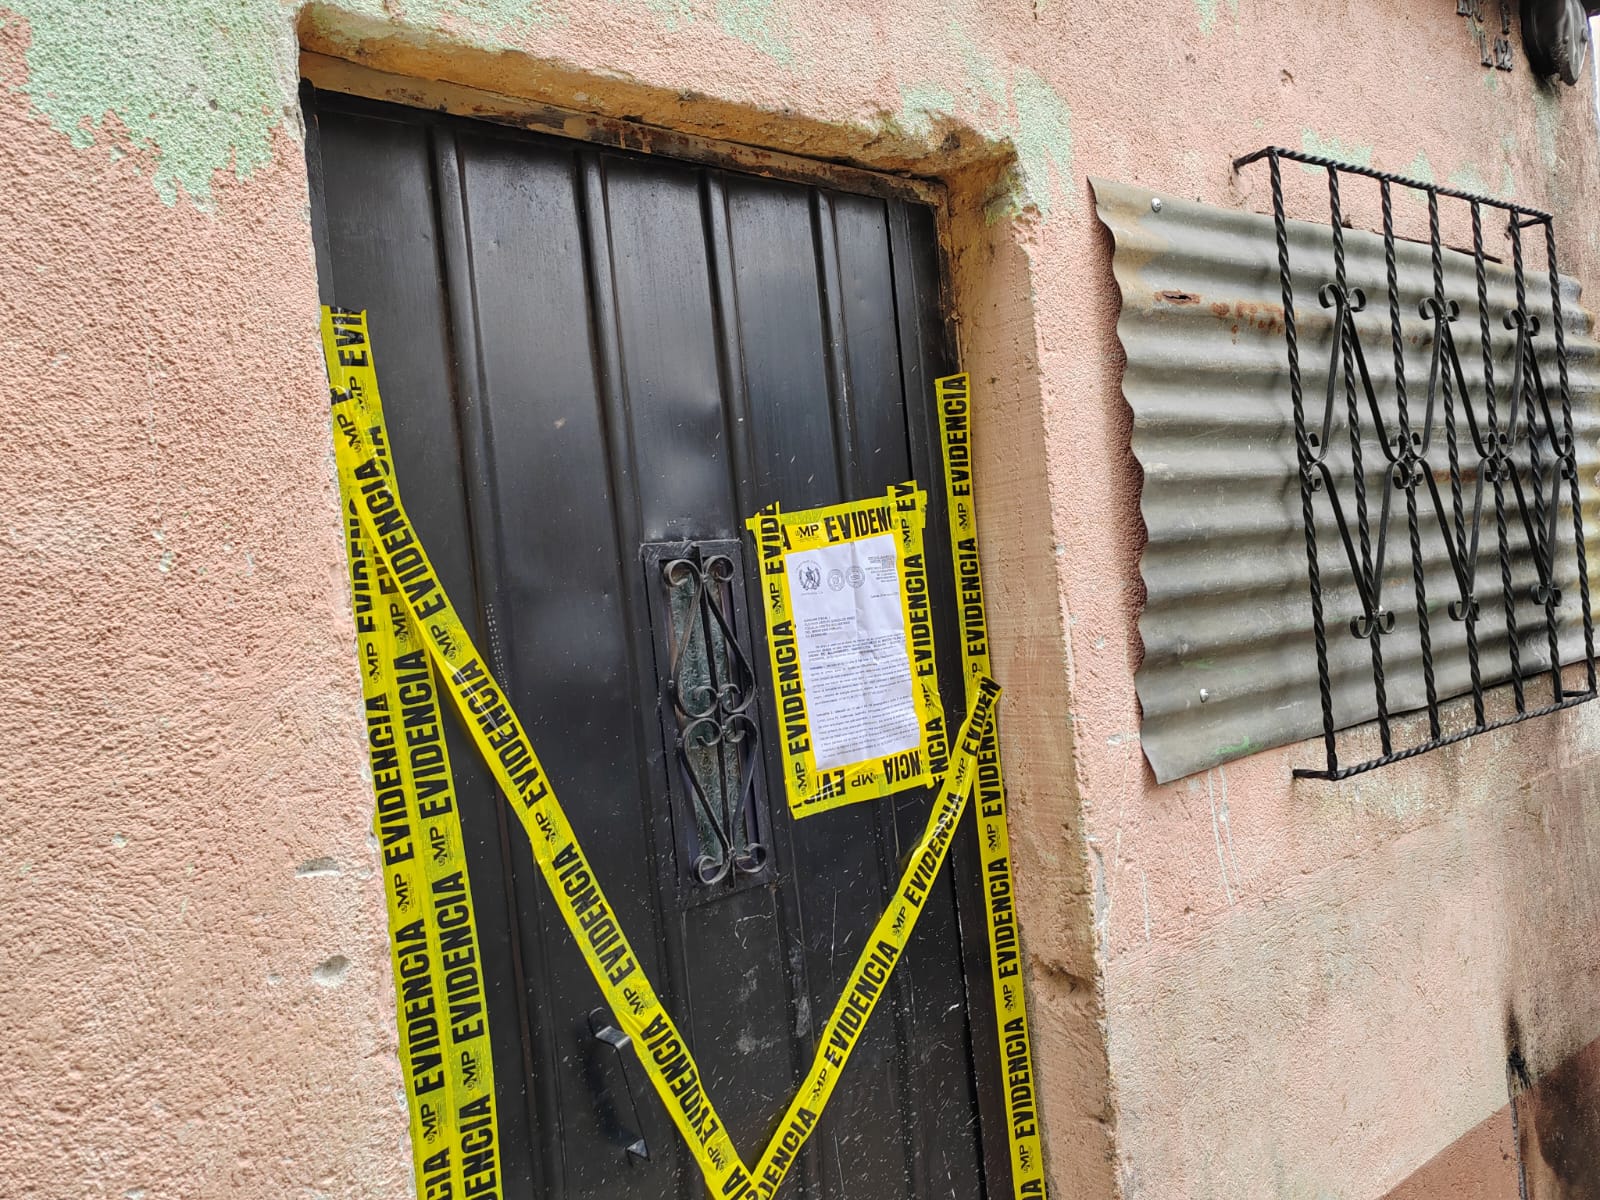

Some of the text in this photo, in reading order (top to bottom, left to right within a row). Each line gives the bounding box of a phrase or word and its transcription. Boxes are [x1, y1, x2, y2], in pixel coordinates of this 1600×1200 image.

[336, 413, 360, 449] MP
[942, 375, 970, 499] EVIDENCIA
[798, 524, 819, 538] MP
[902, 519, 911, 543] MP
[958, 502, 969, 528] MP
[354, 457, 447, 621] EVIDENCIA
[769, 582, 782, 609] MP
[957, 537, 986, 658] EVIDENCIA
[390, 603, 408, 637] MP
[903, 553, 934, 677] EVIDENCIA
[431, 624, 456, 656] MP
[366, 642, 380, 677] MP
[772, 619, 810, 756] EVIDENCIA
[393, 649, 452, 819] EVIDENCIA
[451, 658, 548, 809] EVIDENCIA
[366, 693, 414, 866] EVIDENCIA
[795, 762, 808, 789] MP
[851, 773, 875, 788] MP
[429, 826, 448, 861] MP
[535, 812, 556, 842] MP
[987, 824, 997, 849] MP
[394, 873, 410, 908] MP
[551, 842, 636, 987] EVIDENCIA
[812, 1068, 828, 1096] MP
[824, 940, 898, 1069] EVIDENCIA
[891, 906, 908, 932] MP
[903, 792, 964, 908] EVIDENCIA
[955, 758, 965, 783] MP
[987, 857, 1018, 979] EVIDENCIA
[432, 871, 485, 1044] EVIDENCIA
[395, 919, 445, 1096] EVIDENCIA
[623, 987, 644, 1015] MP
[1003, 984, 1013, 1010] MP
[461, 1051, 477, 1086] MP
[640, 1013, 719, 1148] EVIDENCIA
[1004, 1016, 1036, 1140] EVIDENCIA
[421, 1104, 437, 1139] MP
[708, 1146, 723, 1170] MP
[1018, 1144, 1030, 1170] MP
